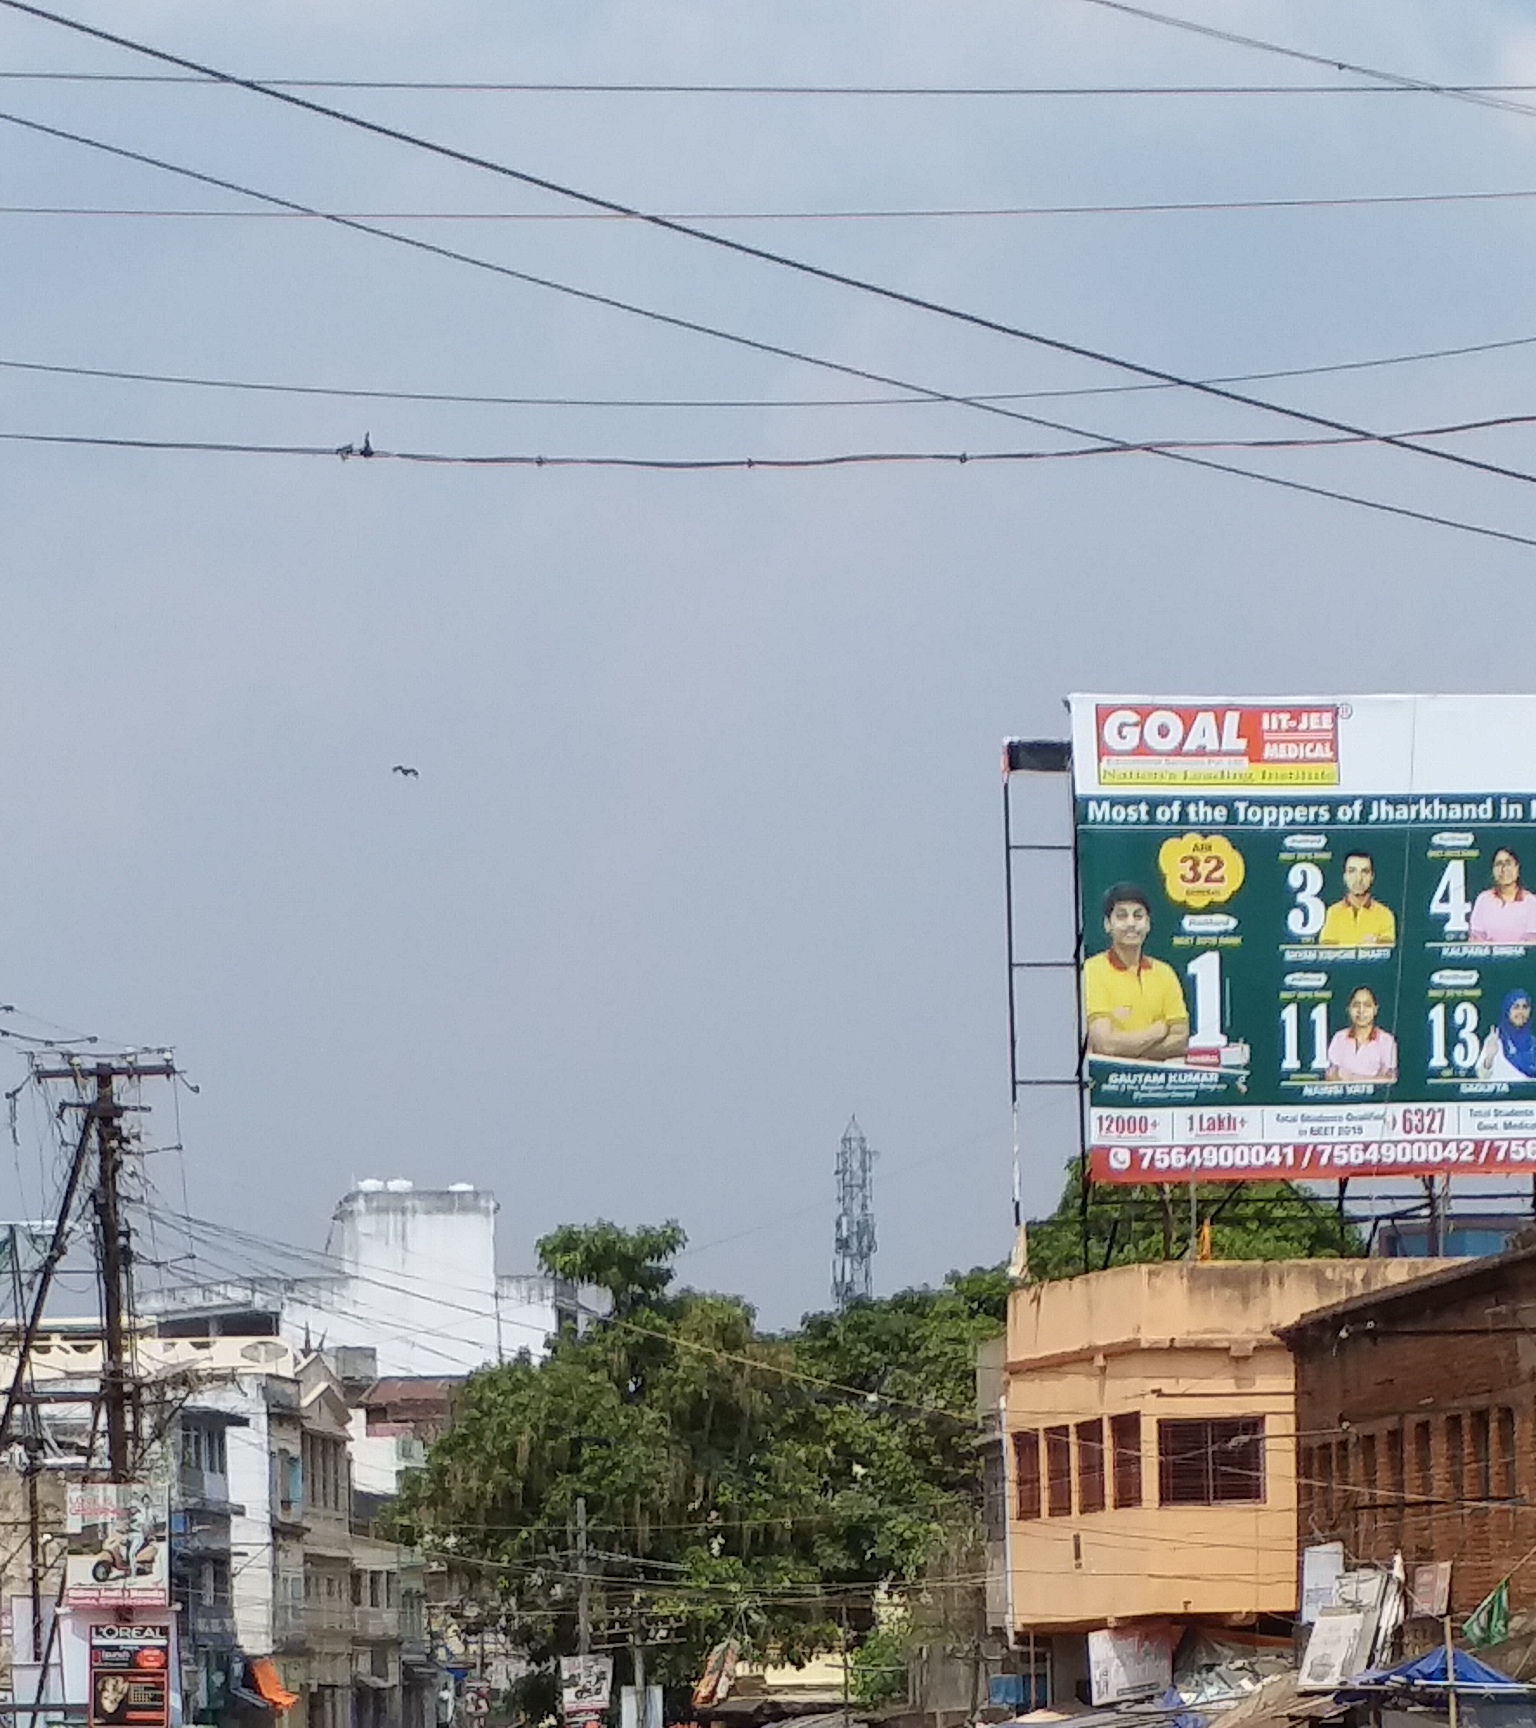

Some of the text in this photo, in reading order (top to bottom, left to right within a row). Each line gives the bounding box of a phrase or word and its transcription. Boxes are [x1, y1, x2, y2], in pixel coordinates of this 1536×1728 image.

[1102, 709, 1334, 754] GOAL IIT-JEE
[1263, 742, 1334, 760] MEDICAL
[1260, 769, 1336, 782] Institute
[1087, 800, 1150, 822] Most
[1155, 800, 1182, 822] of
[1187, 800, 1228, 822] the
[1233, 800, 1331, 827] Toppers
[1336, 799, 1364, 822] of
[1368, 799, 1493, 822] Jharkhand
[1499, 799, 1523, 821] in
[1179, 855, 1227, 884] 32
[1286, 862, 1325, 936] 3
[1429, 859, 1472, 932] 4
[1186, 950, 1228, 1048] 1
[1279, 1002, 1330, 1072] 11
[1428, 1001, 1481, 1069] 13
[1108, 1072, 1220, 1085] GAUTAM KUMAR
[1096, 1114, 1161, 1134] 12000+
[1188, 1112, 1248, 1133] 1 Lakh+
[1401, 1106, 1446, 1135] 6327
[1138, 1143, 1295, 1170] 7564900041
[1301, 1144, 1312, 1169] /
[1314, 1139, 1478, 1166] 7564900042
[1478, 1141, 1489, 1164] /
